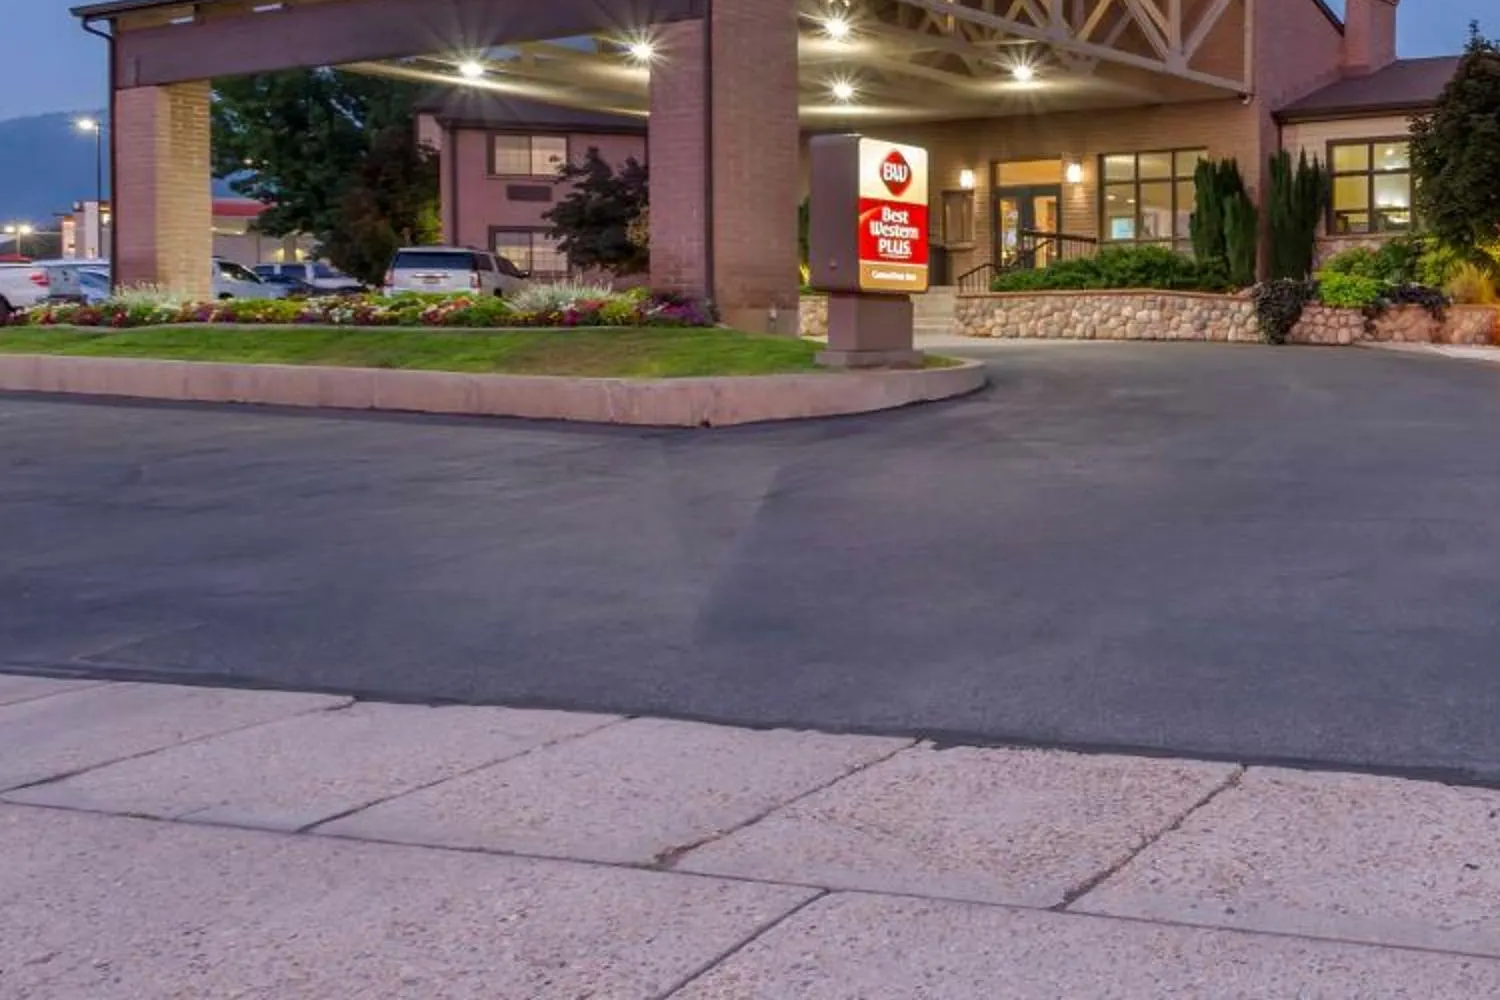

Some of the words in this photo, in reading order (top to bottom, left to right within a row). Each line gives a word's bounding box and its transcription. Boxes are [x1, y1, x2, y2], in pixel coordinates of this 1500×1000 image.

[883, 162, 908, 182] BW
[881, 207, 909, 224] Best
[869, 220, 919, 239] Western
[879, 239, 911, 255] PLUS
